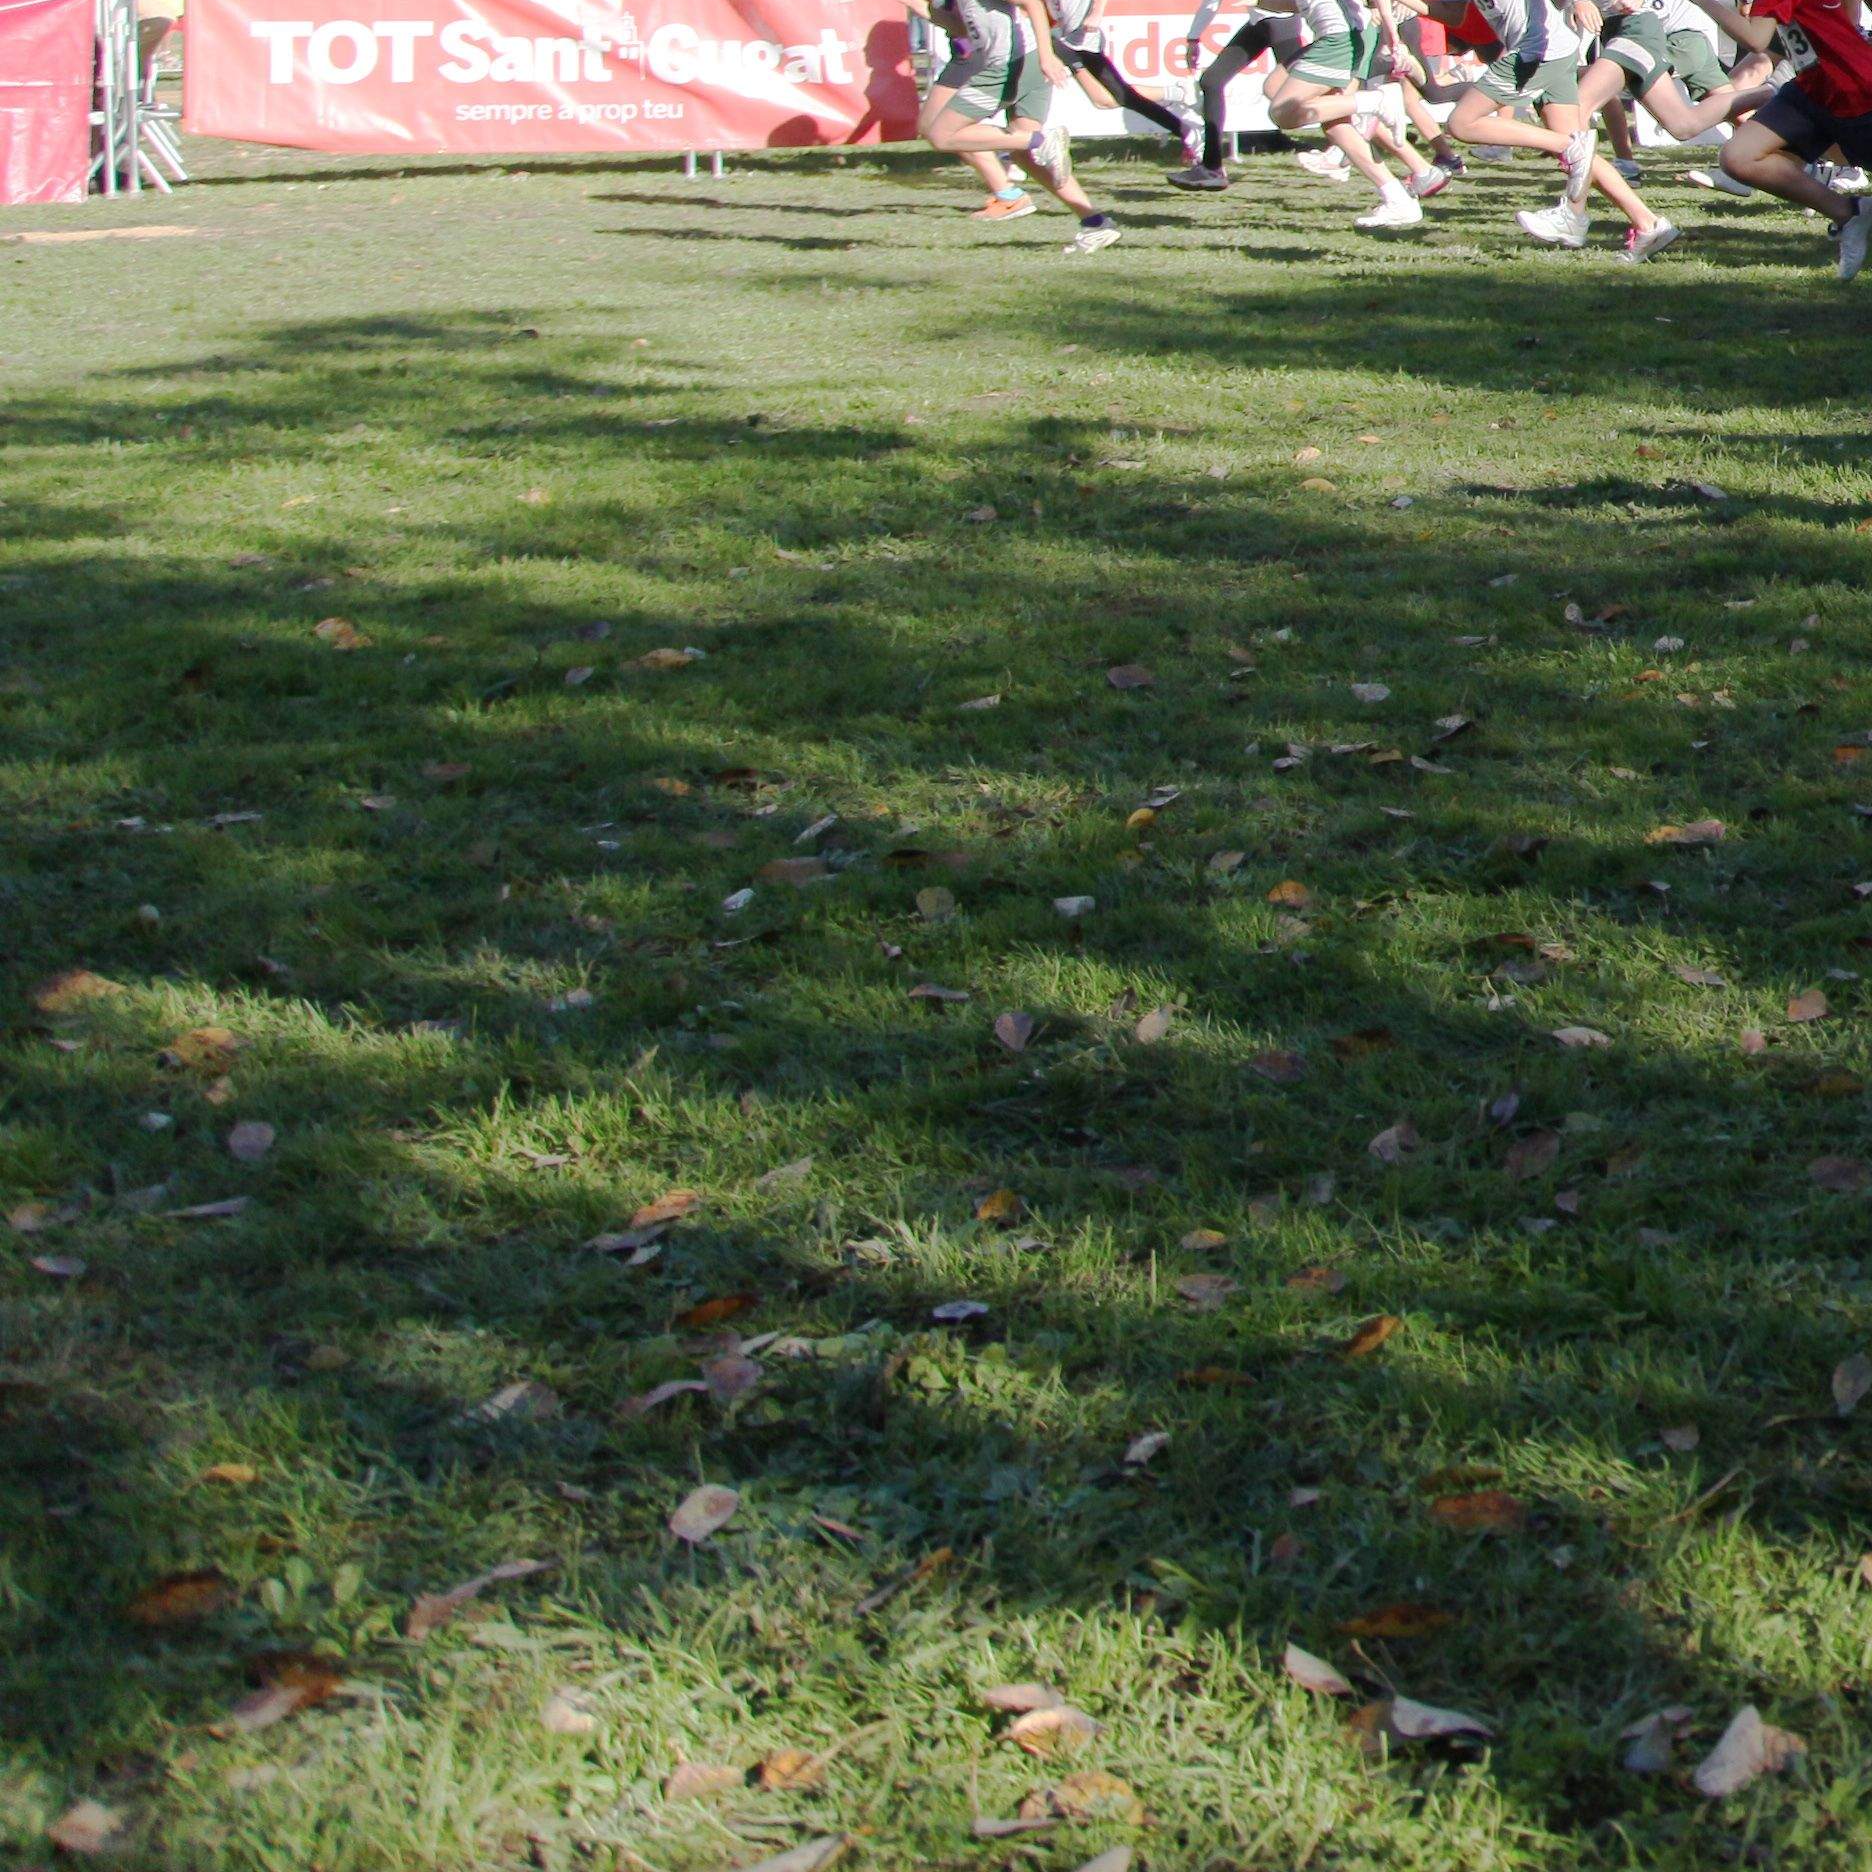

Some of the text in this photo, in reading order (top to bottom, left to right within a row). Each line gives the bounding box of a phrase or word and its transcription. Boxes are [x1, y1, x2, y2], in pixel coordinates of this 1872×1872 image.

[249, 19, 853, 90] TOT Sant Cugat
[456, 103, 552, 126] sempre
[578, 101, 638, 124] prop
[642, 99, 684, 120] teu
